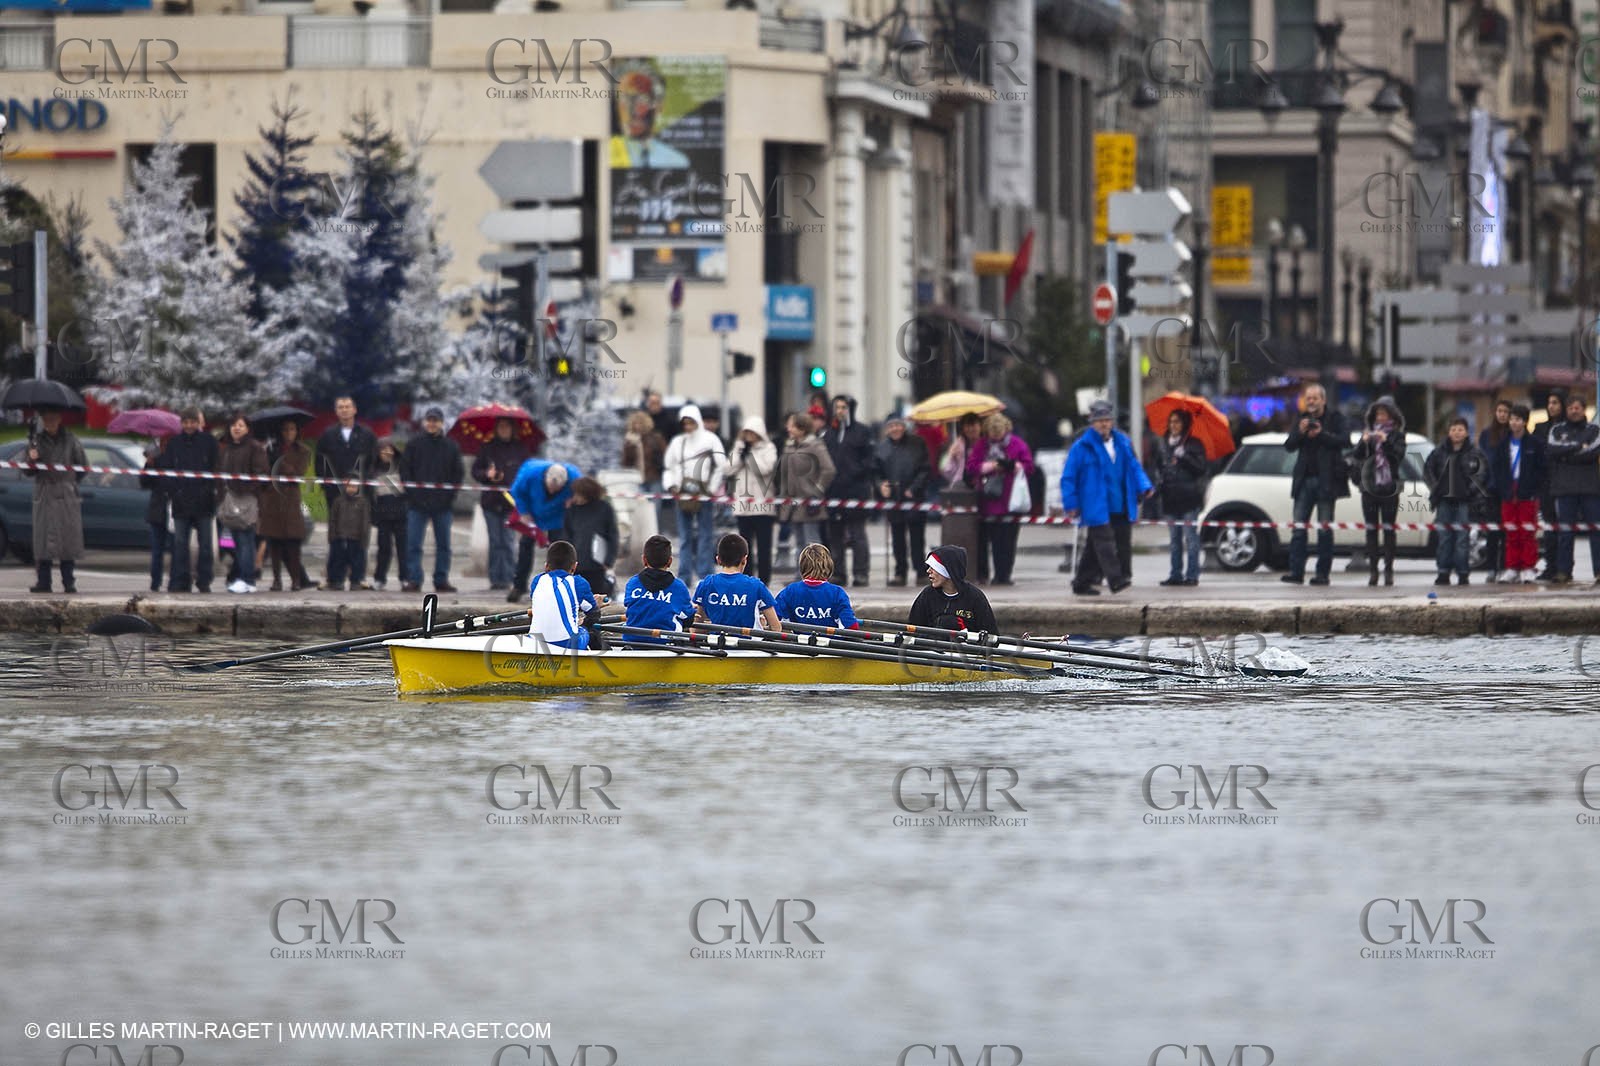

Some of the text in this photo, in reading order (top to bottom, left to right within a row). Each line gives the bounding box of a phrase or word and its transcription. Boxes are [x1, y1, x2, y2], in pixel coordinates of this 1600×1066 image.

[0, 97, 108, 133] NOD
[631, 588, 673, 603] CAM
[708, 592, 747, 606] CAM
[424, 598, 433, 632] 1
[794, 606, 832, 619] CAM
